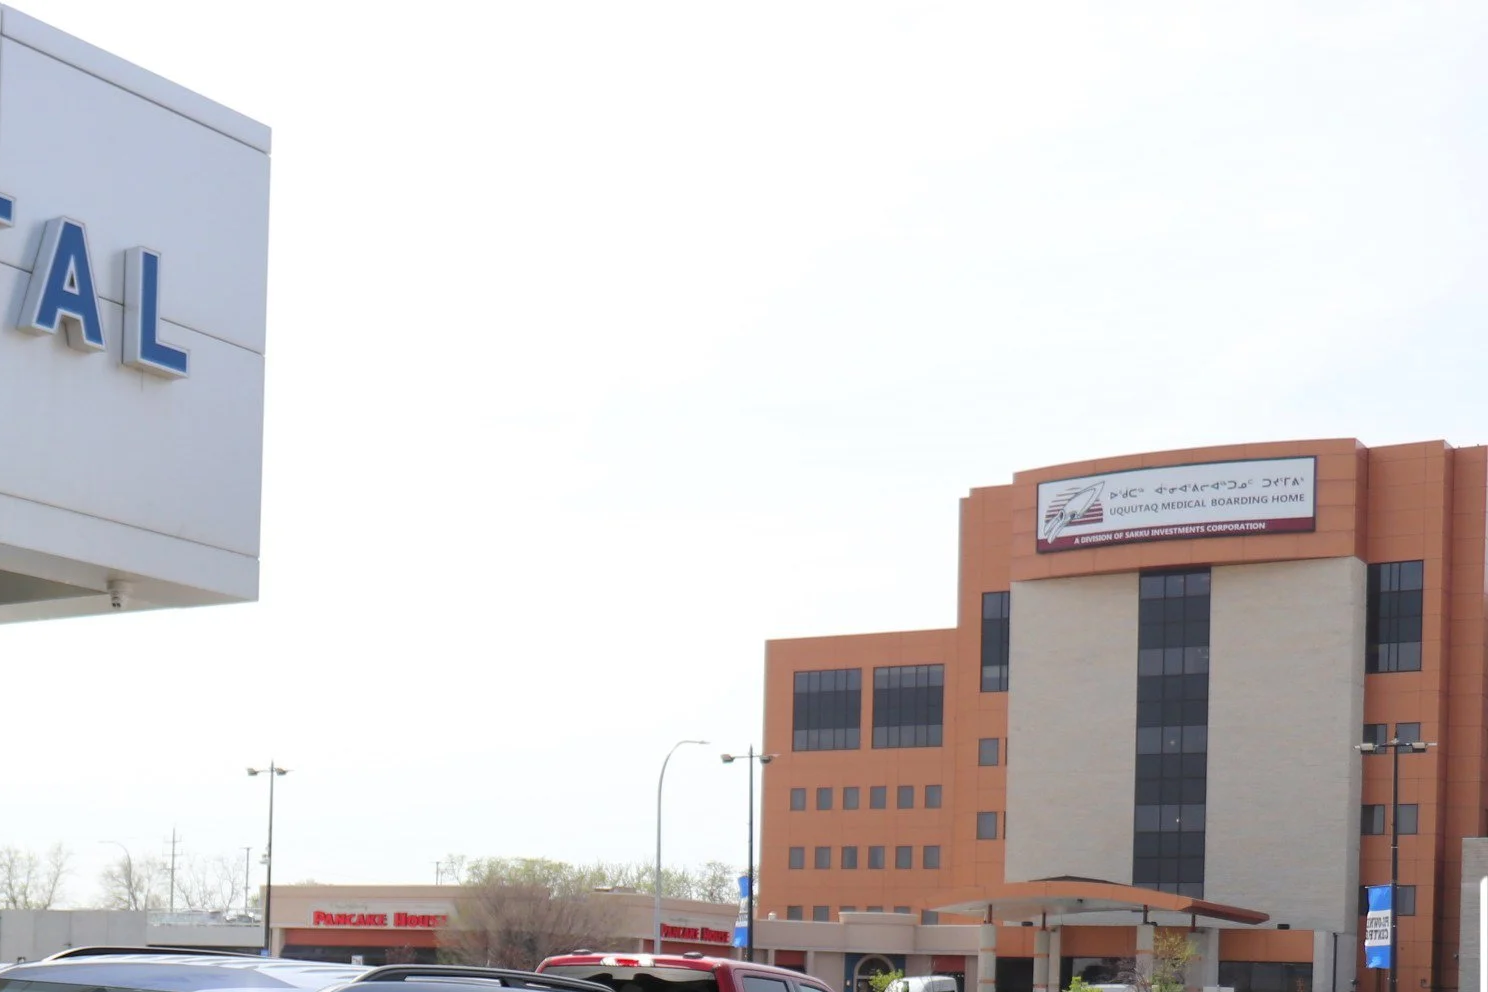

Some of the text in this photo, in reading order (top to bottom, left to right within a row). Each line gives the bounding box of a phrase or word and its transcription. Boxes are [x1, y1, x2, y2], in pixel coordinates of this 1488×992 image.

[1109, 493, 1305, 516] UQUUTAQ MEDICAL BOARDING HOME
[1081, 533, 1112, 544] DIVISION
[1114, 532, 1123, 540] OF
[1151, 524, 1205, 536] INVESTMENTS
[1207, 521, 1266, 533] CORPORATION
